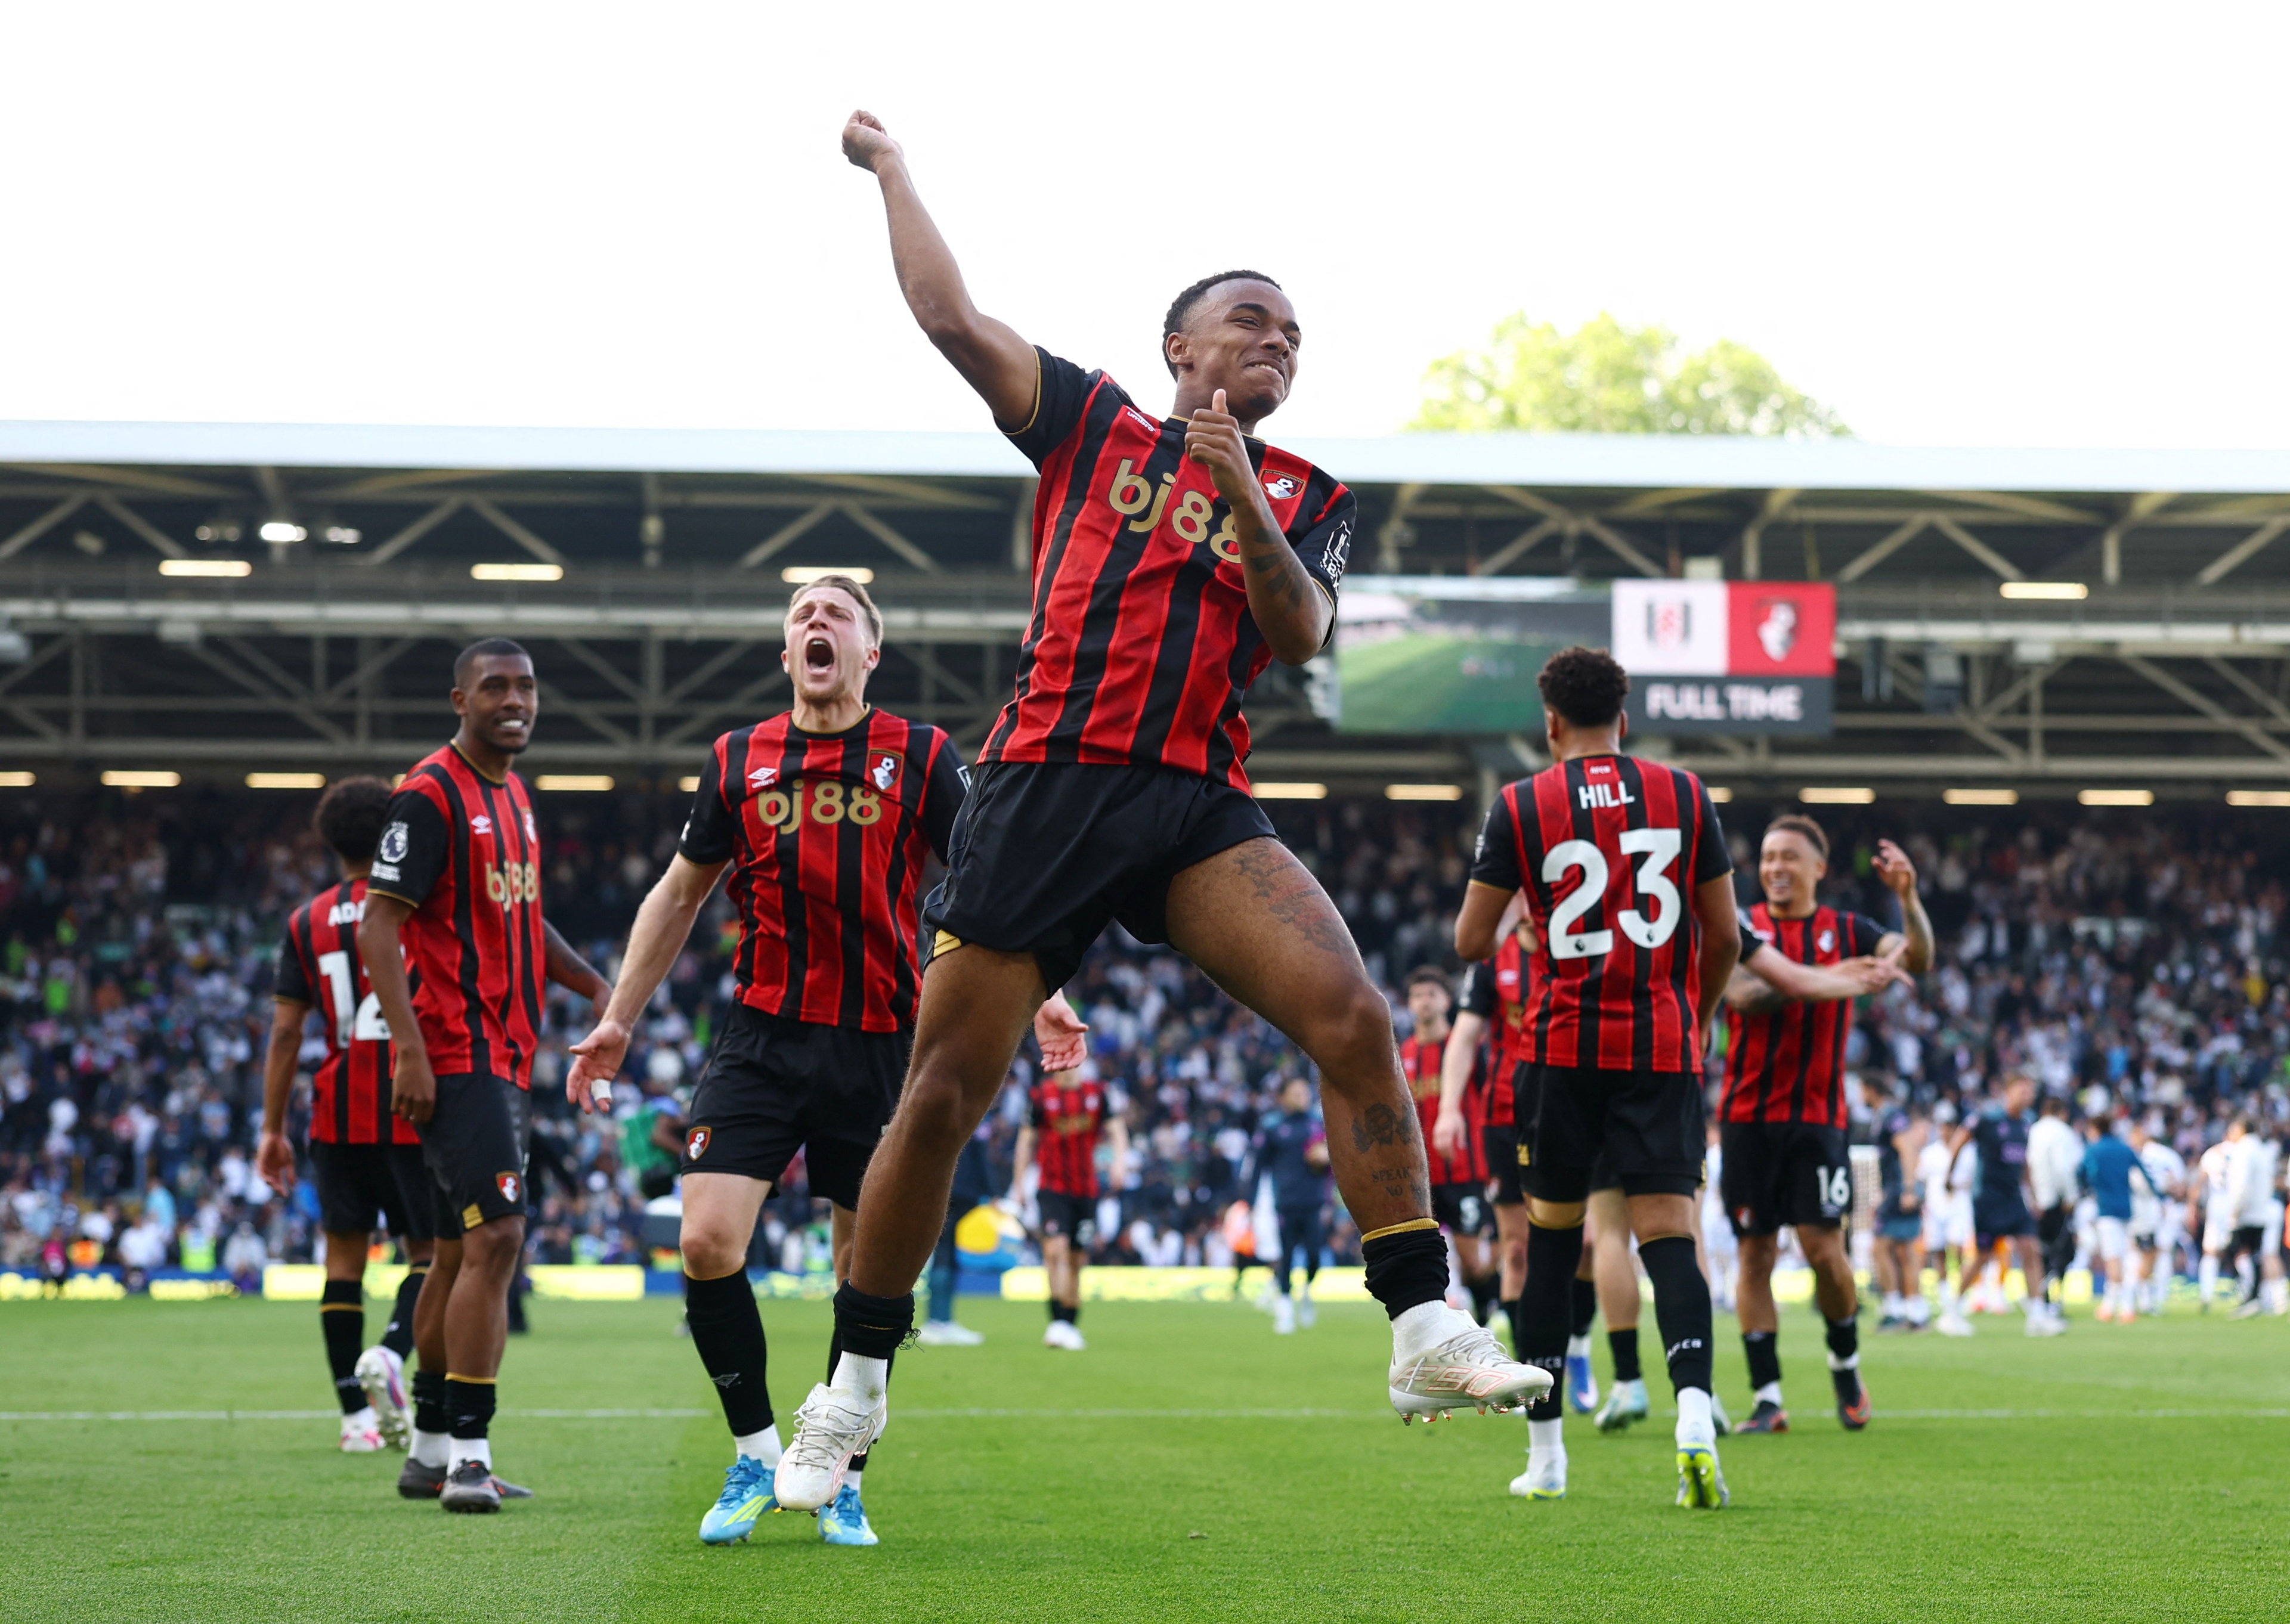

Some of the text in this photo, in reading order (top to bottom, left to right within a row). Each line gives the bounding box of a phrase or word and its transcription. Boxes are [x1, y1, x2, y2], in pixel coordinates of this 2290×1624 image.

[1127, 411, 1154, 432] umbro
[1109, 458, 1242, 563] bj88
[1645, 683, 1803, 721] FULL TIME
[751, 777, 775, 789] umbro
[1578, 780, 1636, 810] HILL
[757, 779, 882, 835] bj88
[485, 860, 539, 912] bj88
[1541, 828, 1681, 960] 23
[1372, 1166, 1409, 1183] SPEAK
[1816, 1165, 1850, 1207] 16
[1392, 1365, 1511, 1397] F50
